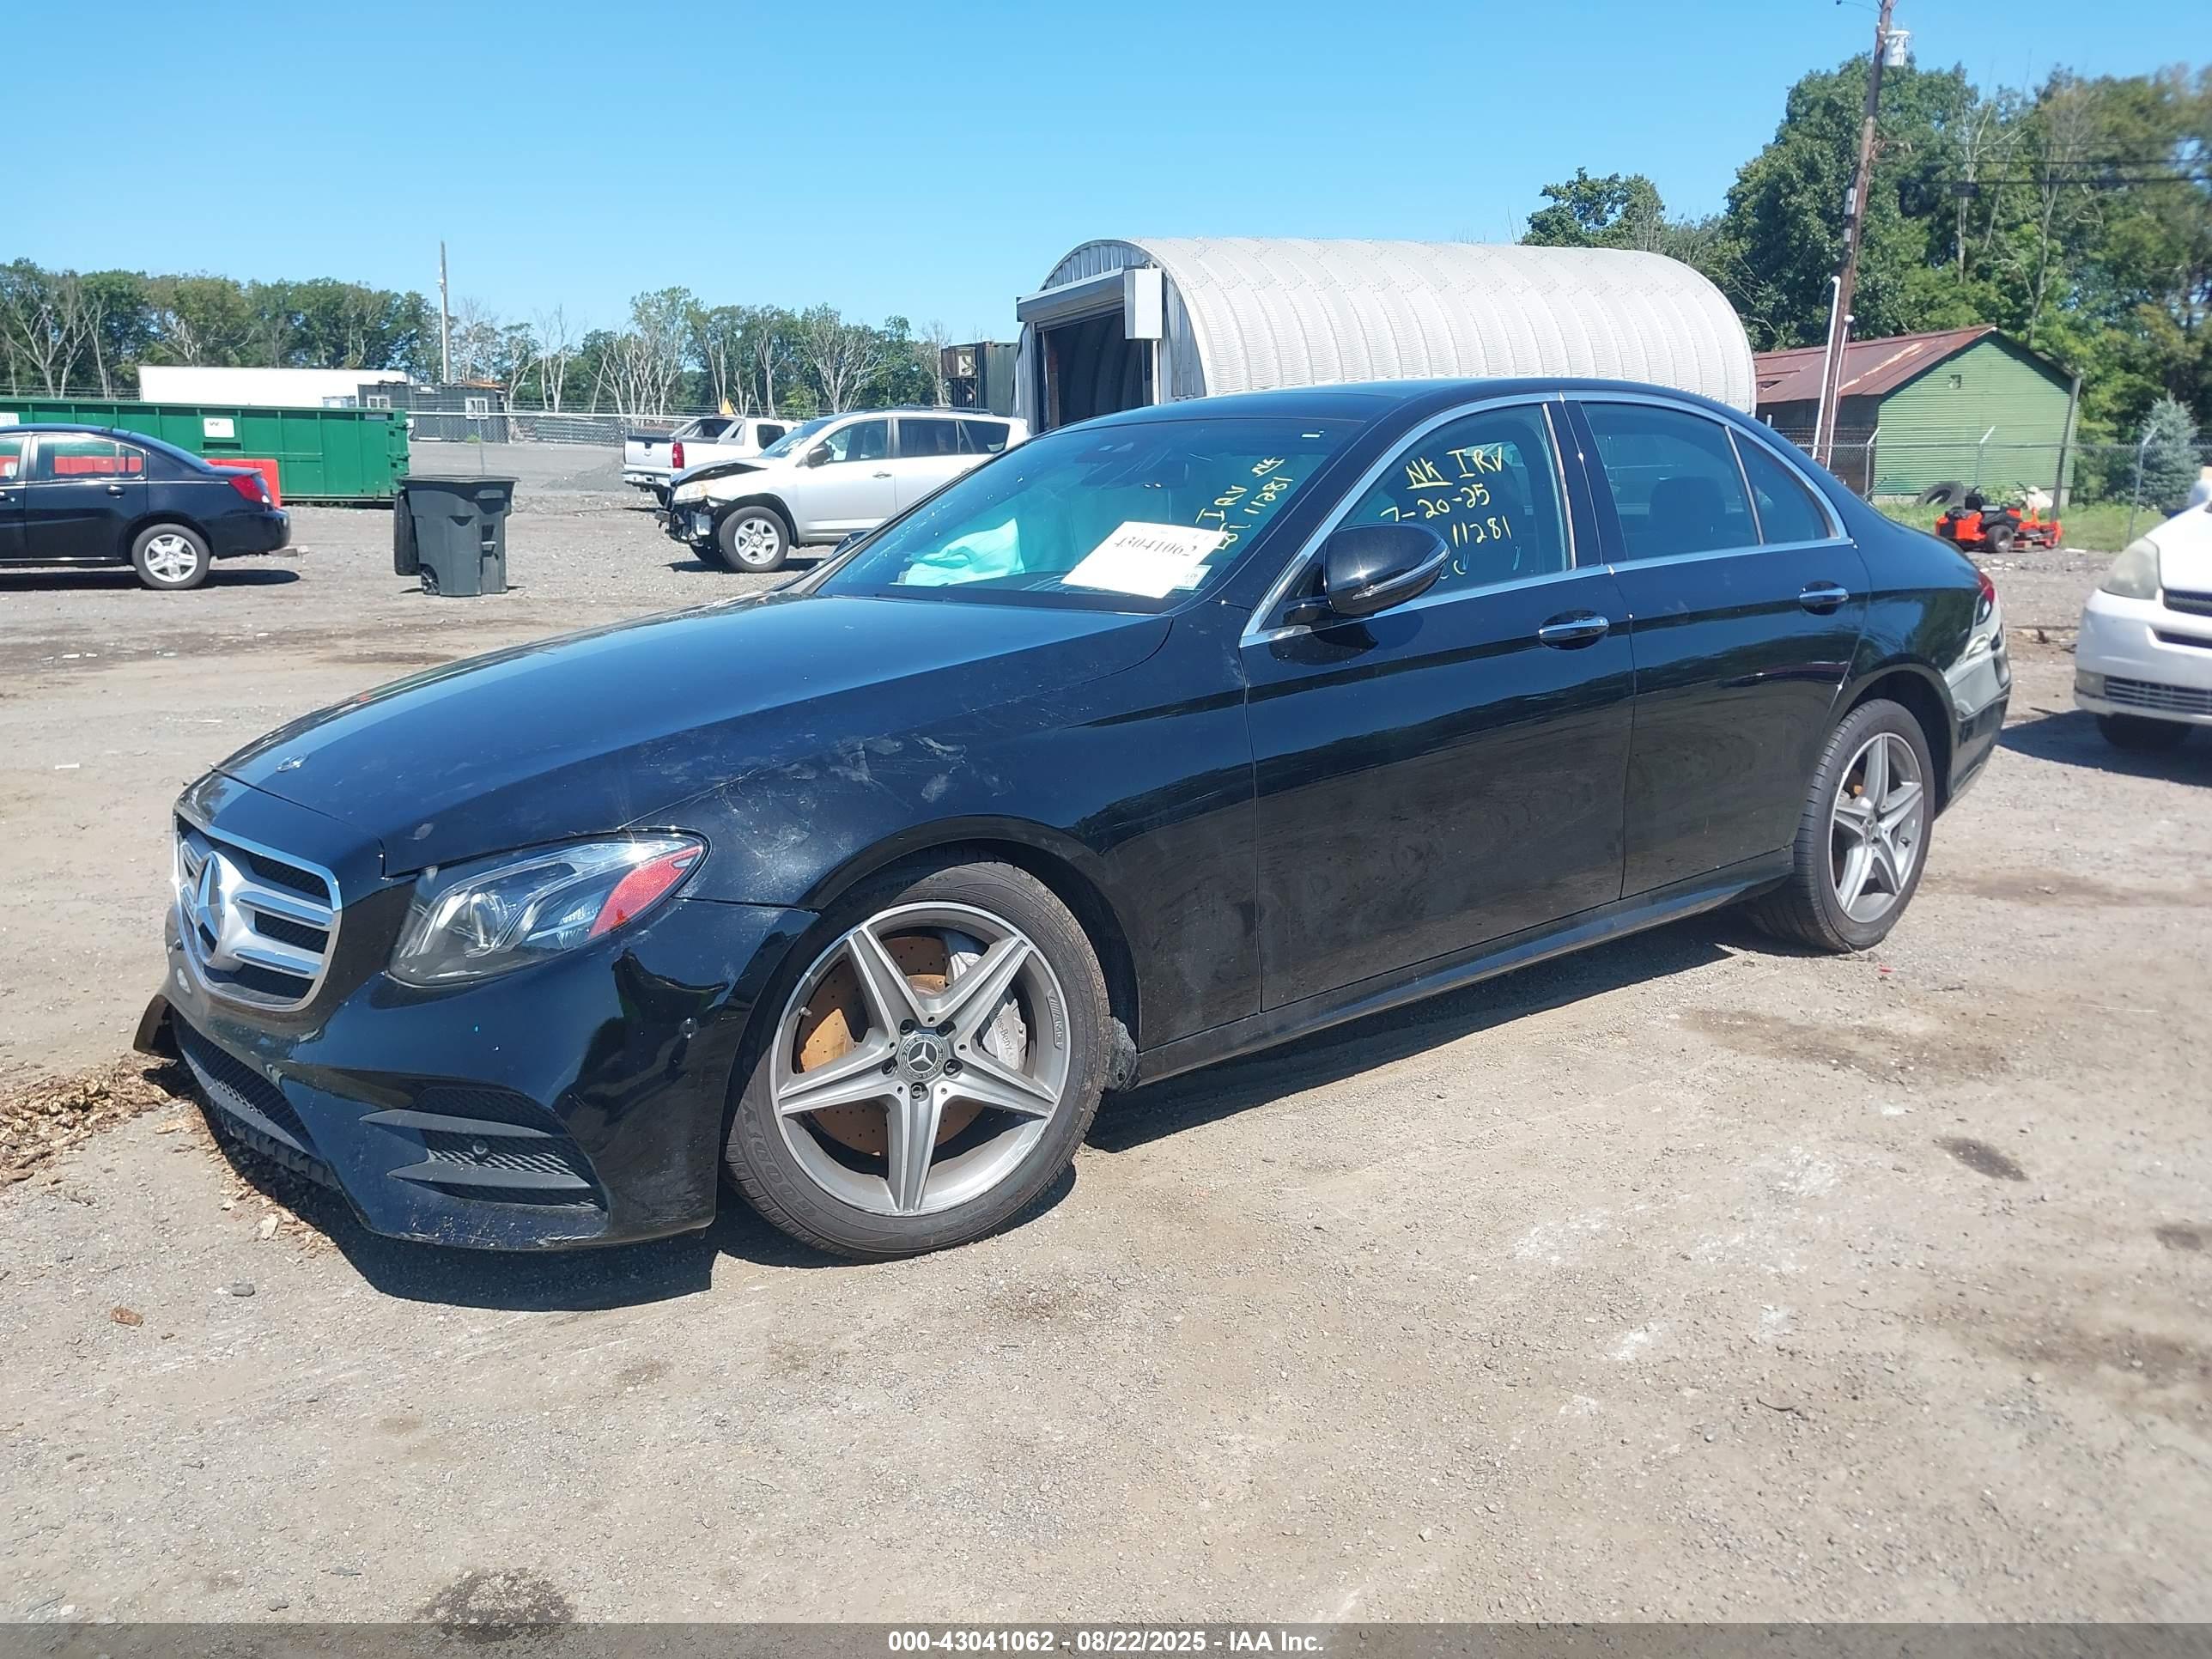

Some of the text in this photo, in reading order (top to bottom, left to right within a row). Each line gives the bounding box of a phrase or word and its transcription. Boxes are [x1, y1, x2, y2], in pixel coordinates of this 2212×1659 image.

[1404, 456, 1454, 490] NK
[1243, 476, 1294, 515] 11281
[1379, 482, 1491, 523] 7-20-25
[1452, 514, 1513, 549] 11281
